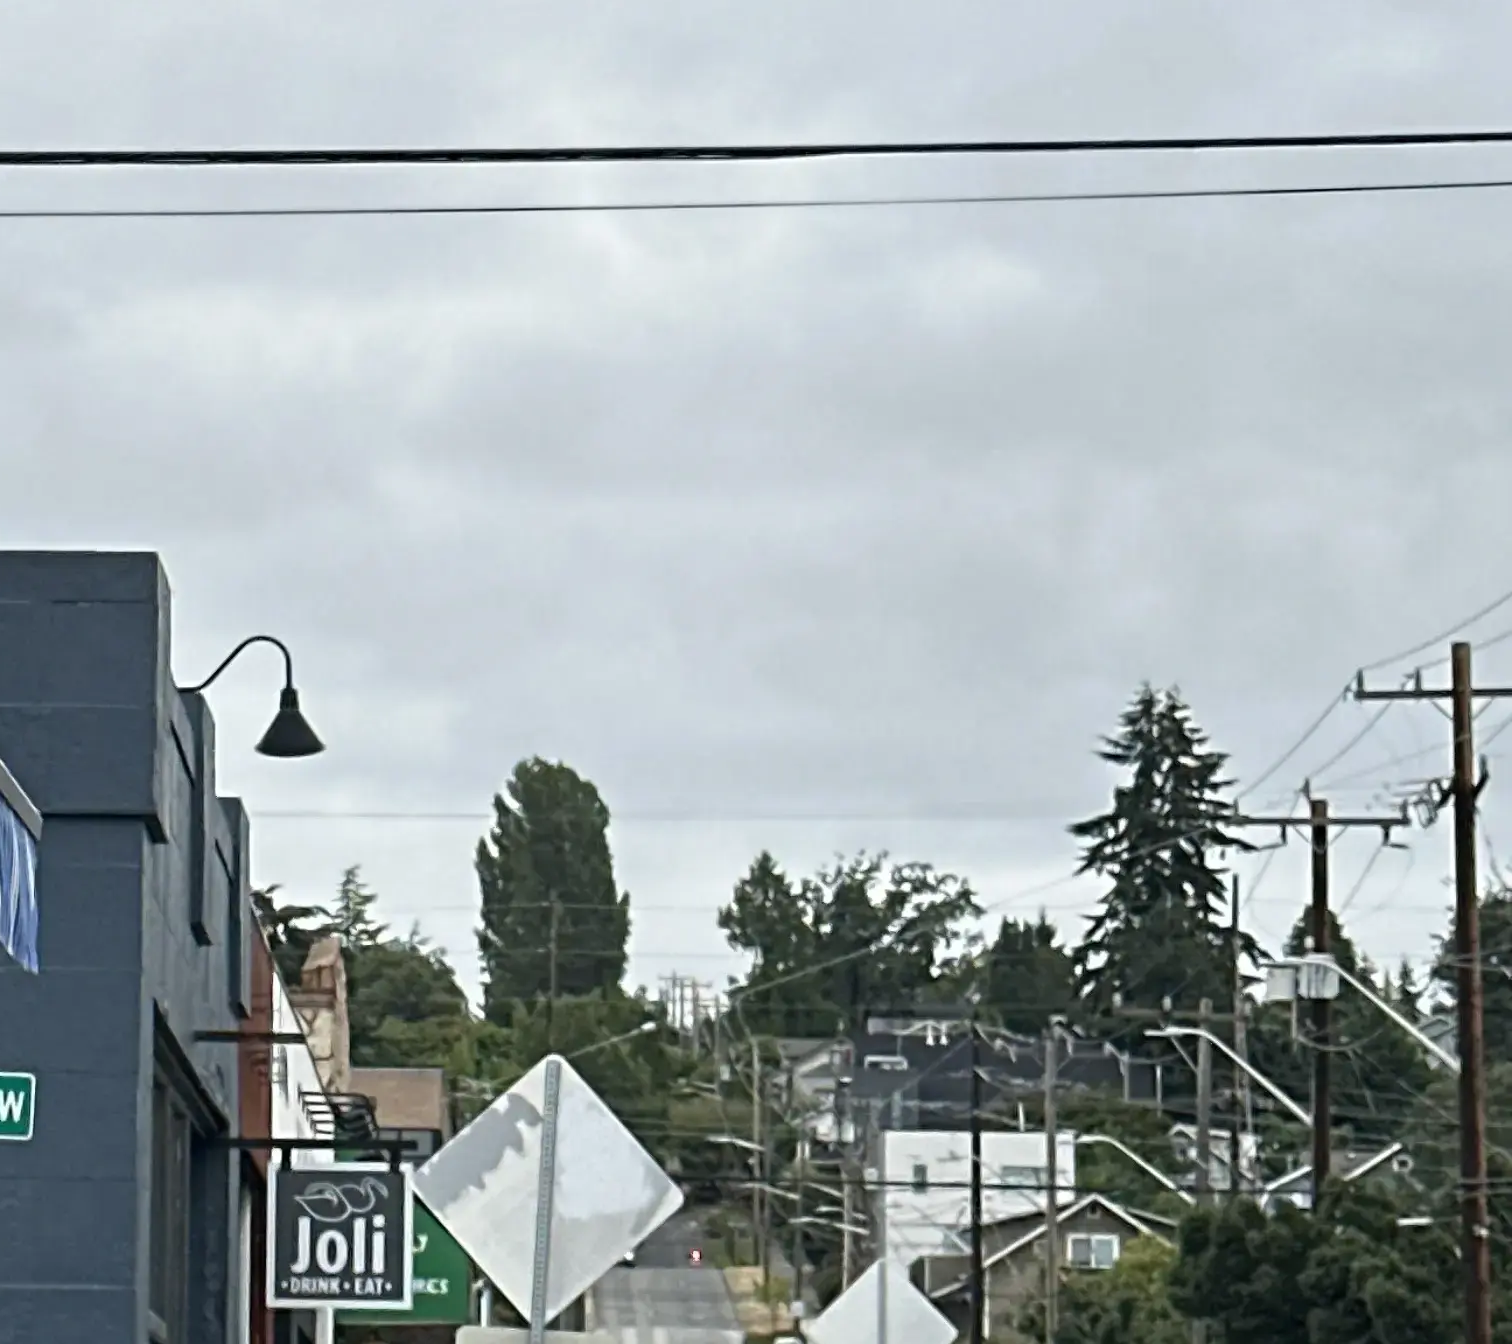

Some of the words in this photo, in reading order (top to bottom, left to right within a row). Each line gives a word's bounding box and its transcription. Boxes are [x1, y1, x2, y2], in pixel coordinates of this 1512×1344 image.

[290, 1214, 386, 1275] Joli
[289, 1277, 341, 1295] DRINK
[354, 1277, 384, 1295] EAT
